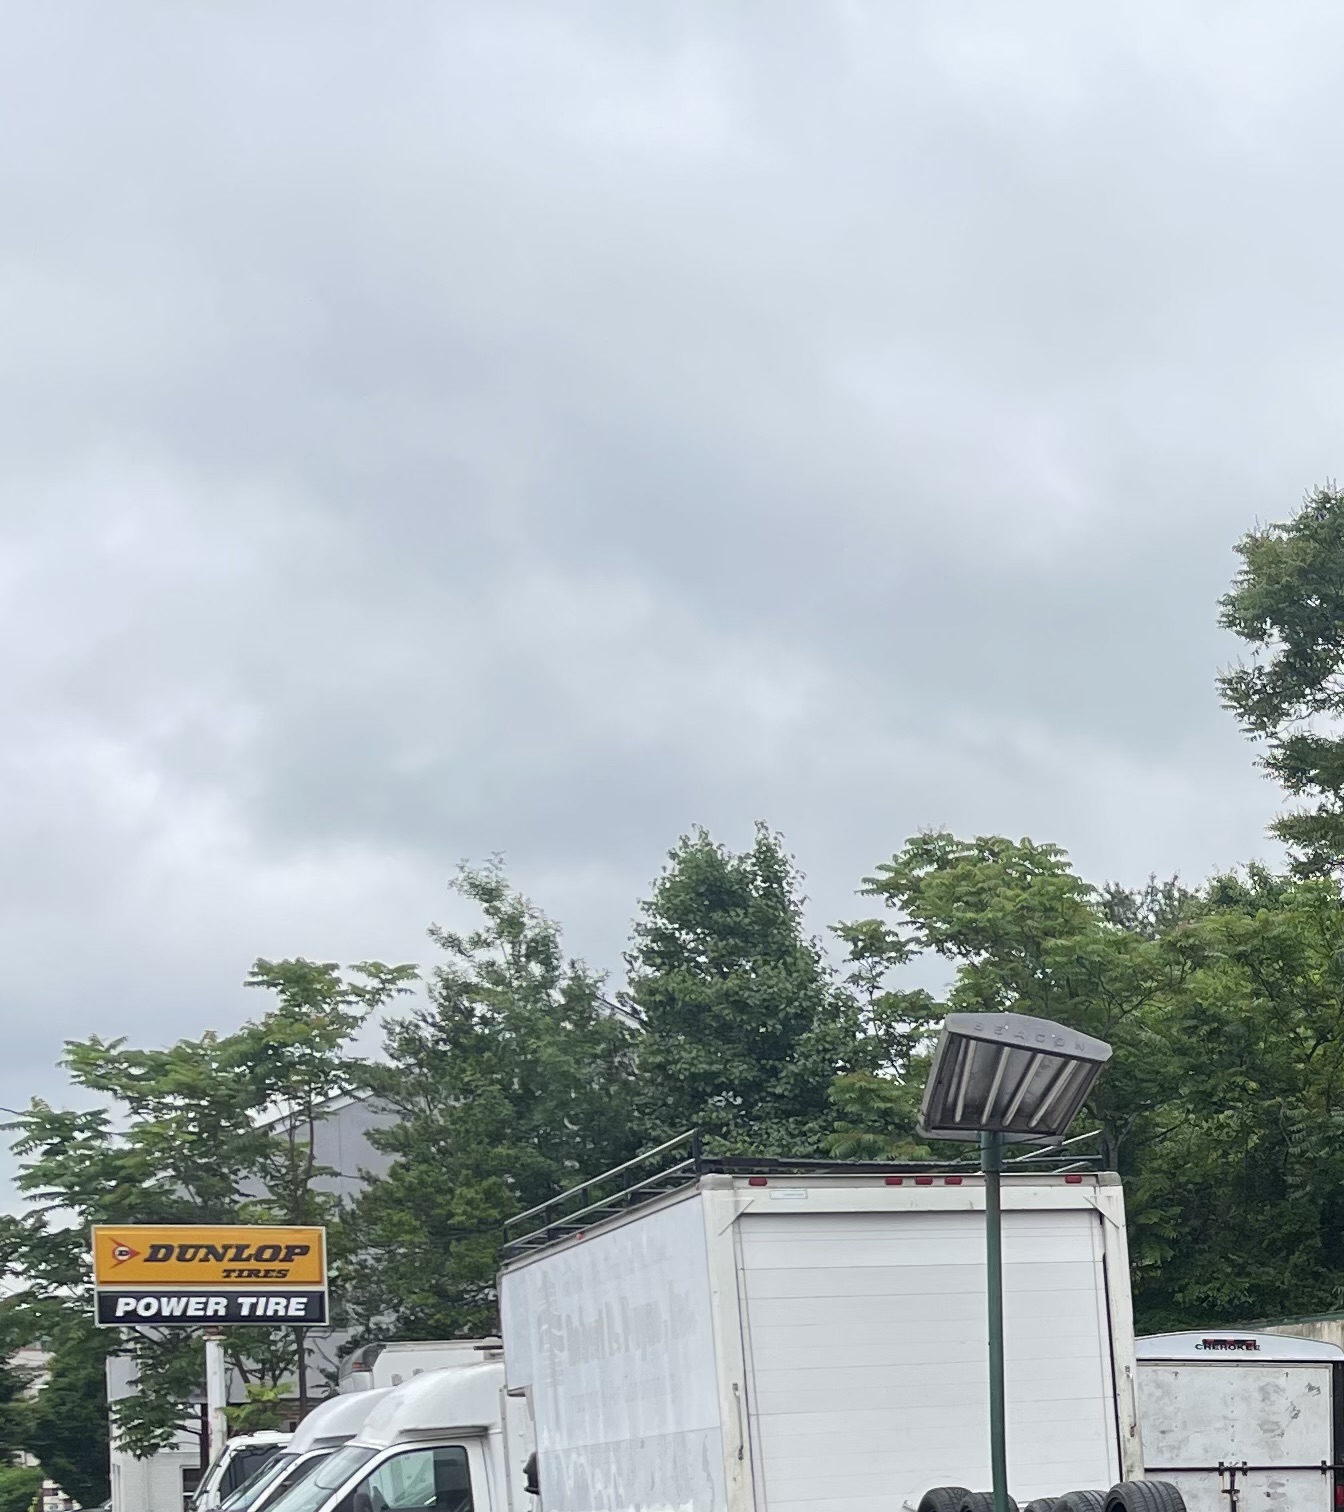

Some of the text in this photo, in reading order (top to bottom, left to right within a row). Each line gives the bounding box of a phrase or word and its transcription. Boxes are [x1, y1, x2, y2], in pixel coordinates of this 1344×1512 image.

[974, 1022, 1085, 1052] BEACON
[143, 1243, 310, 1263] DUNLOP
[221, 1268, 290, 1279] TIRES
[115, 1297, 308, 1317] POWER TIRE
[1195, 1343, 1260, 1351] CHEROKEE
